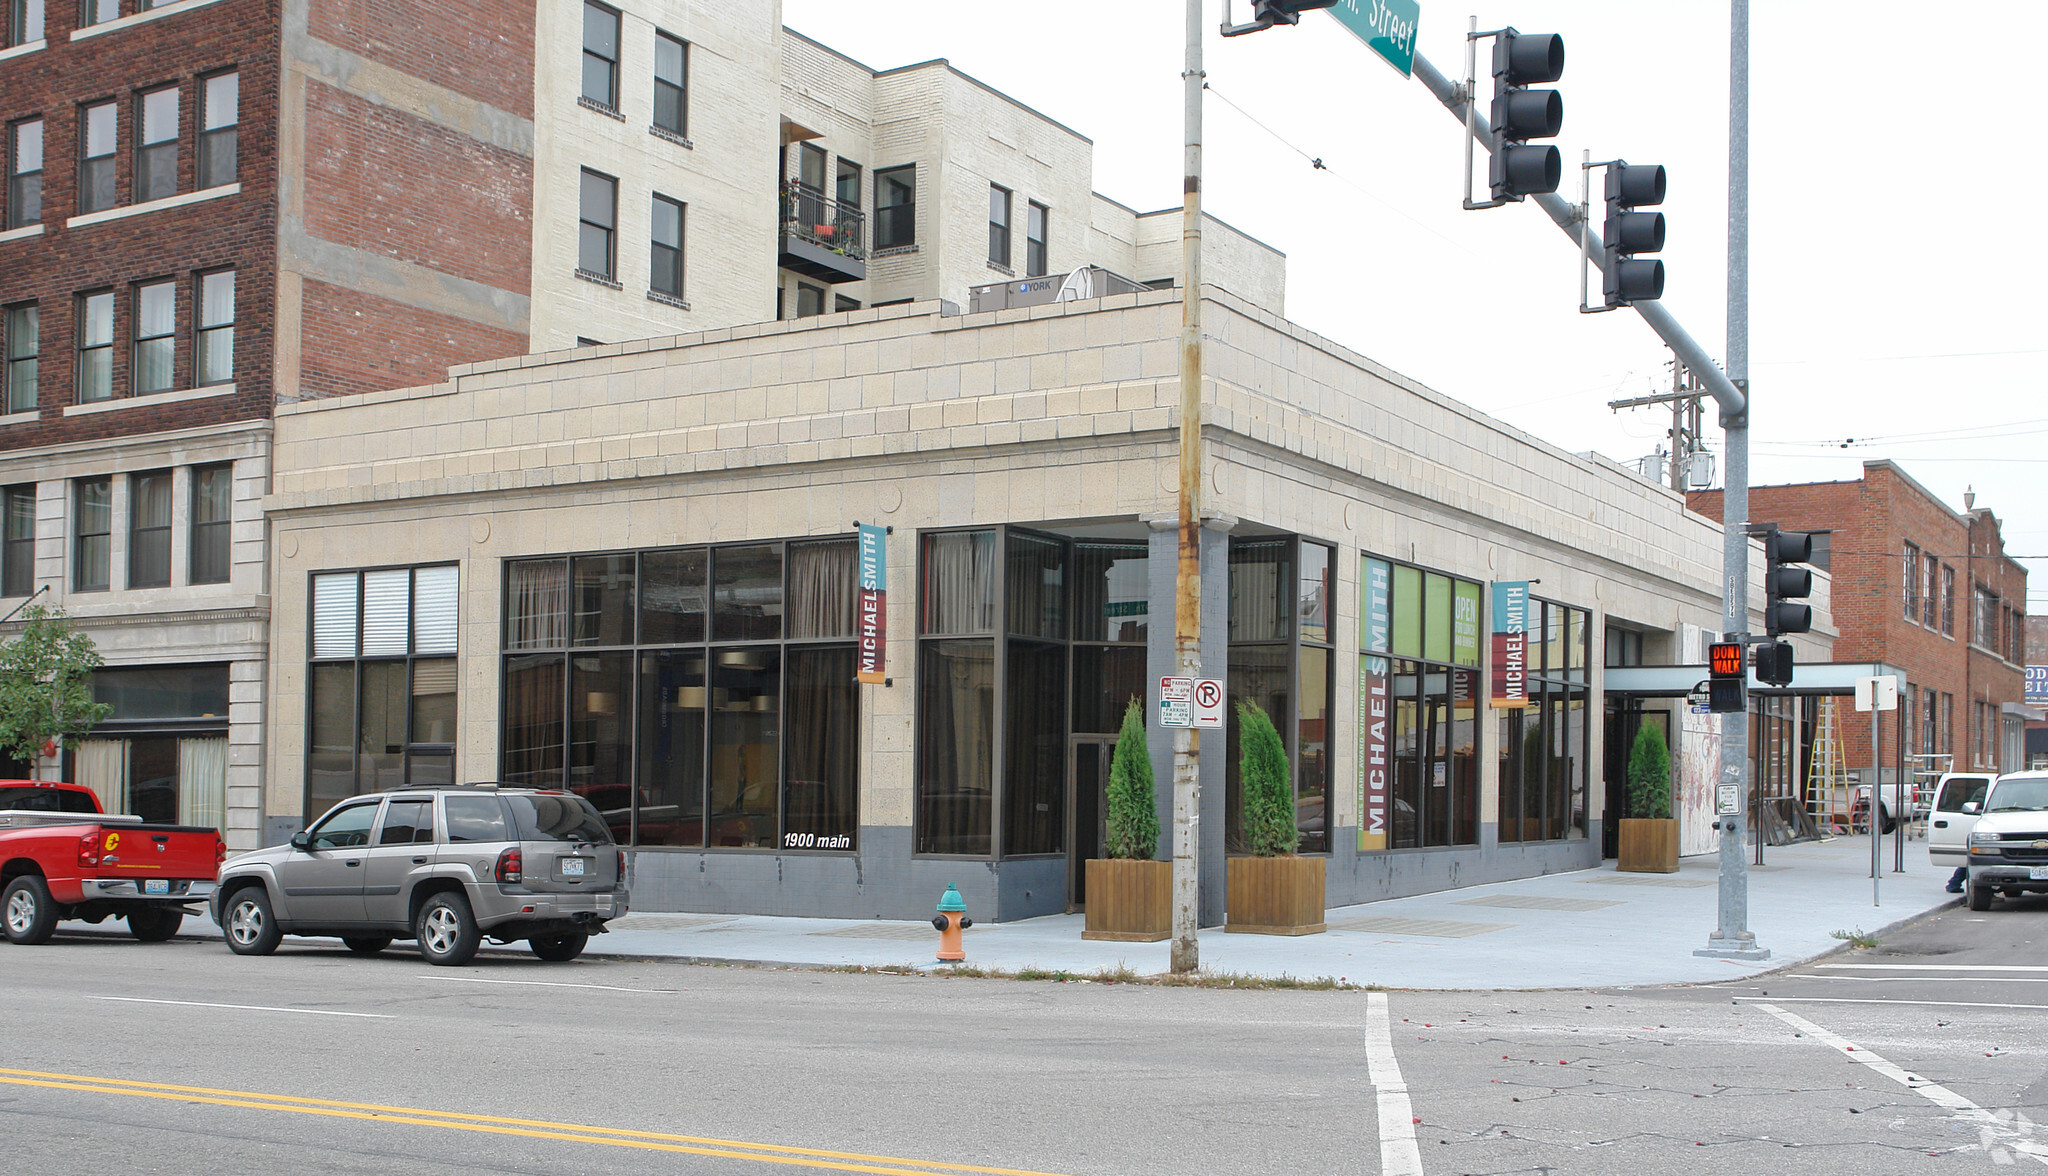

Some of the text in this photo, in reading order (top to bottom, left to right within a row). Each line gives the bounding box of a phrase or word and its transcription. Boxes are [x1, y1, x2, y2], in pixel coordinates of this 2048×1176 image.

[1369, 0, 1414, 56] Street
[1028, 280, 1051, 292] YORK
[862, 532, 876, 674] MICHAELSMITH
[1455, 596, 1476, 623] OPEN
[1506, 587, 1524, 700] MICHAELSMITH
[1713, 659, 1741, 674] WALK
[784, 832, 850, 849] 1900 main
